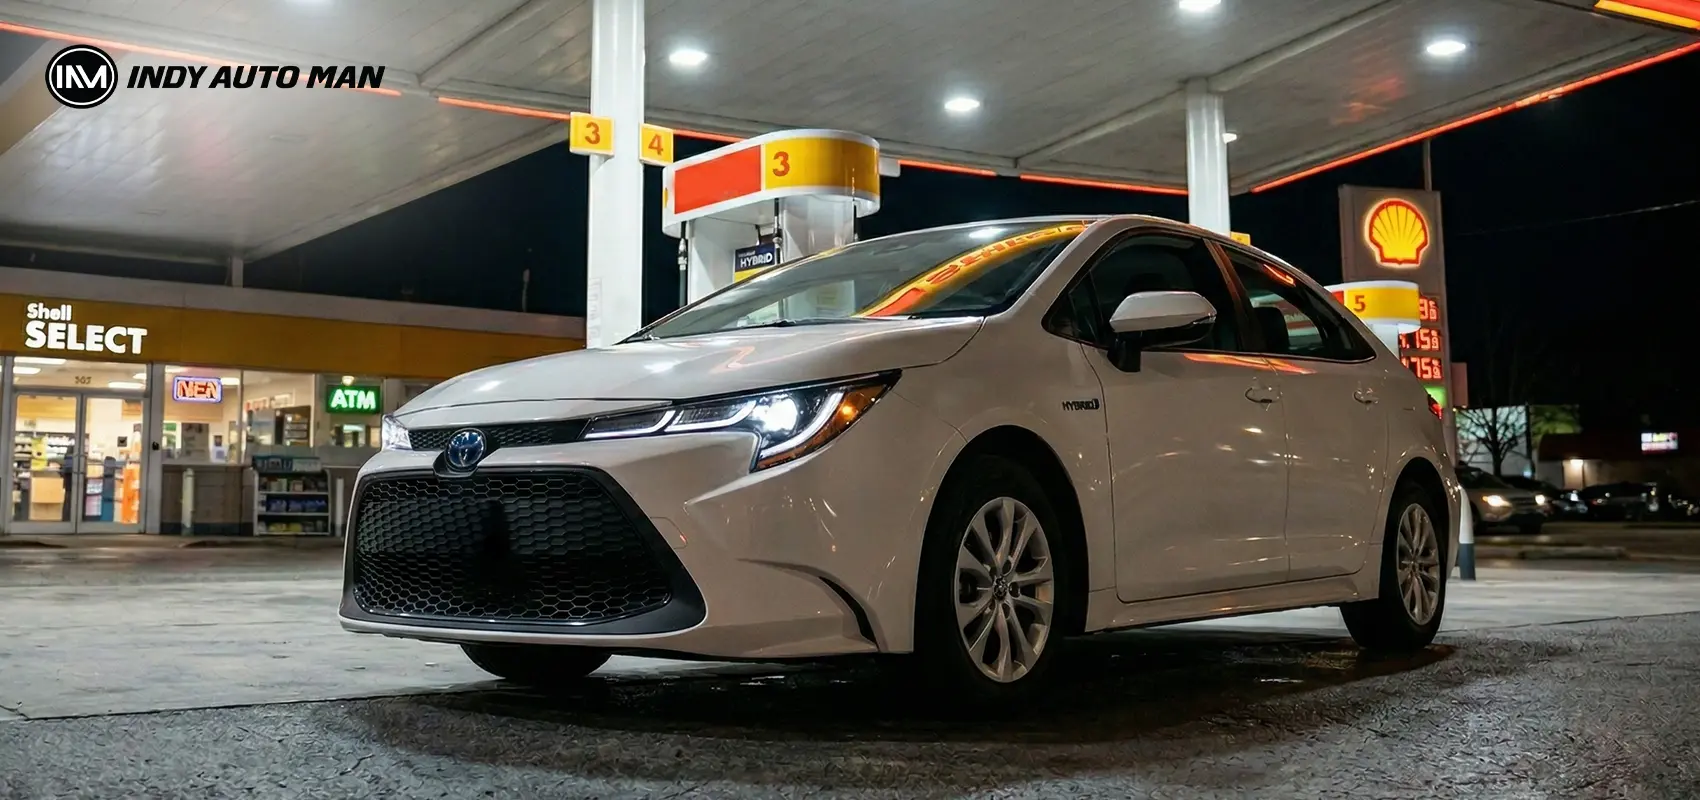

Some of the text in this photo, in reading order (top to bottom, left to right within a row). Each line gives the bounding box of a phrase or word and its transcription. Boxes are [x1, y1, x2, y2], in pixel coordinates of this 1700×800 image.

[584, 122, 601, 144] 3
[647, 133, 664, 156] 4
[772, 151, 790, 177] 3
[740, 252, 773, 268] HYBRID
[26, 302, 72, 321] Shell
[1353, 295, 1366, 312] 5
[24, 321, 148, 355] SELECT
[330, 388, 377, 410] ATM
